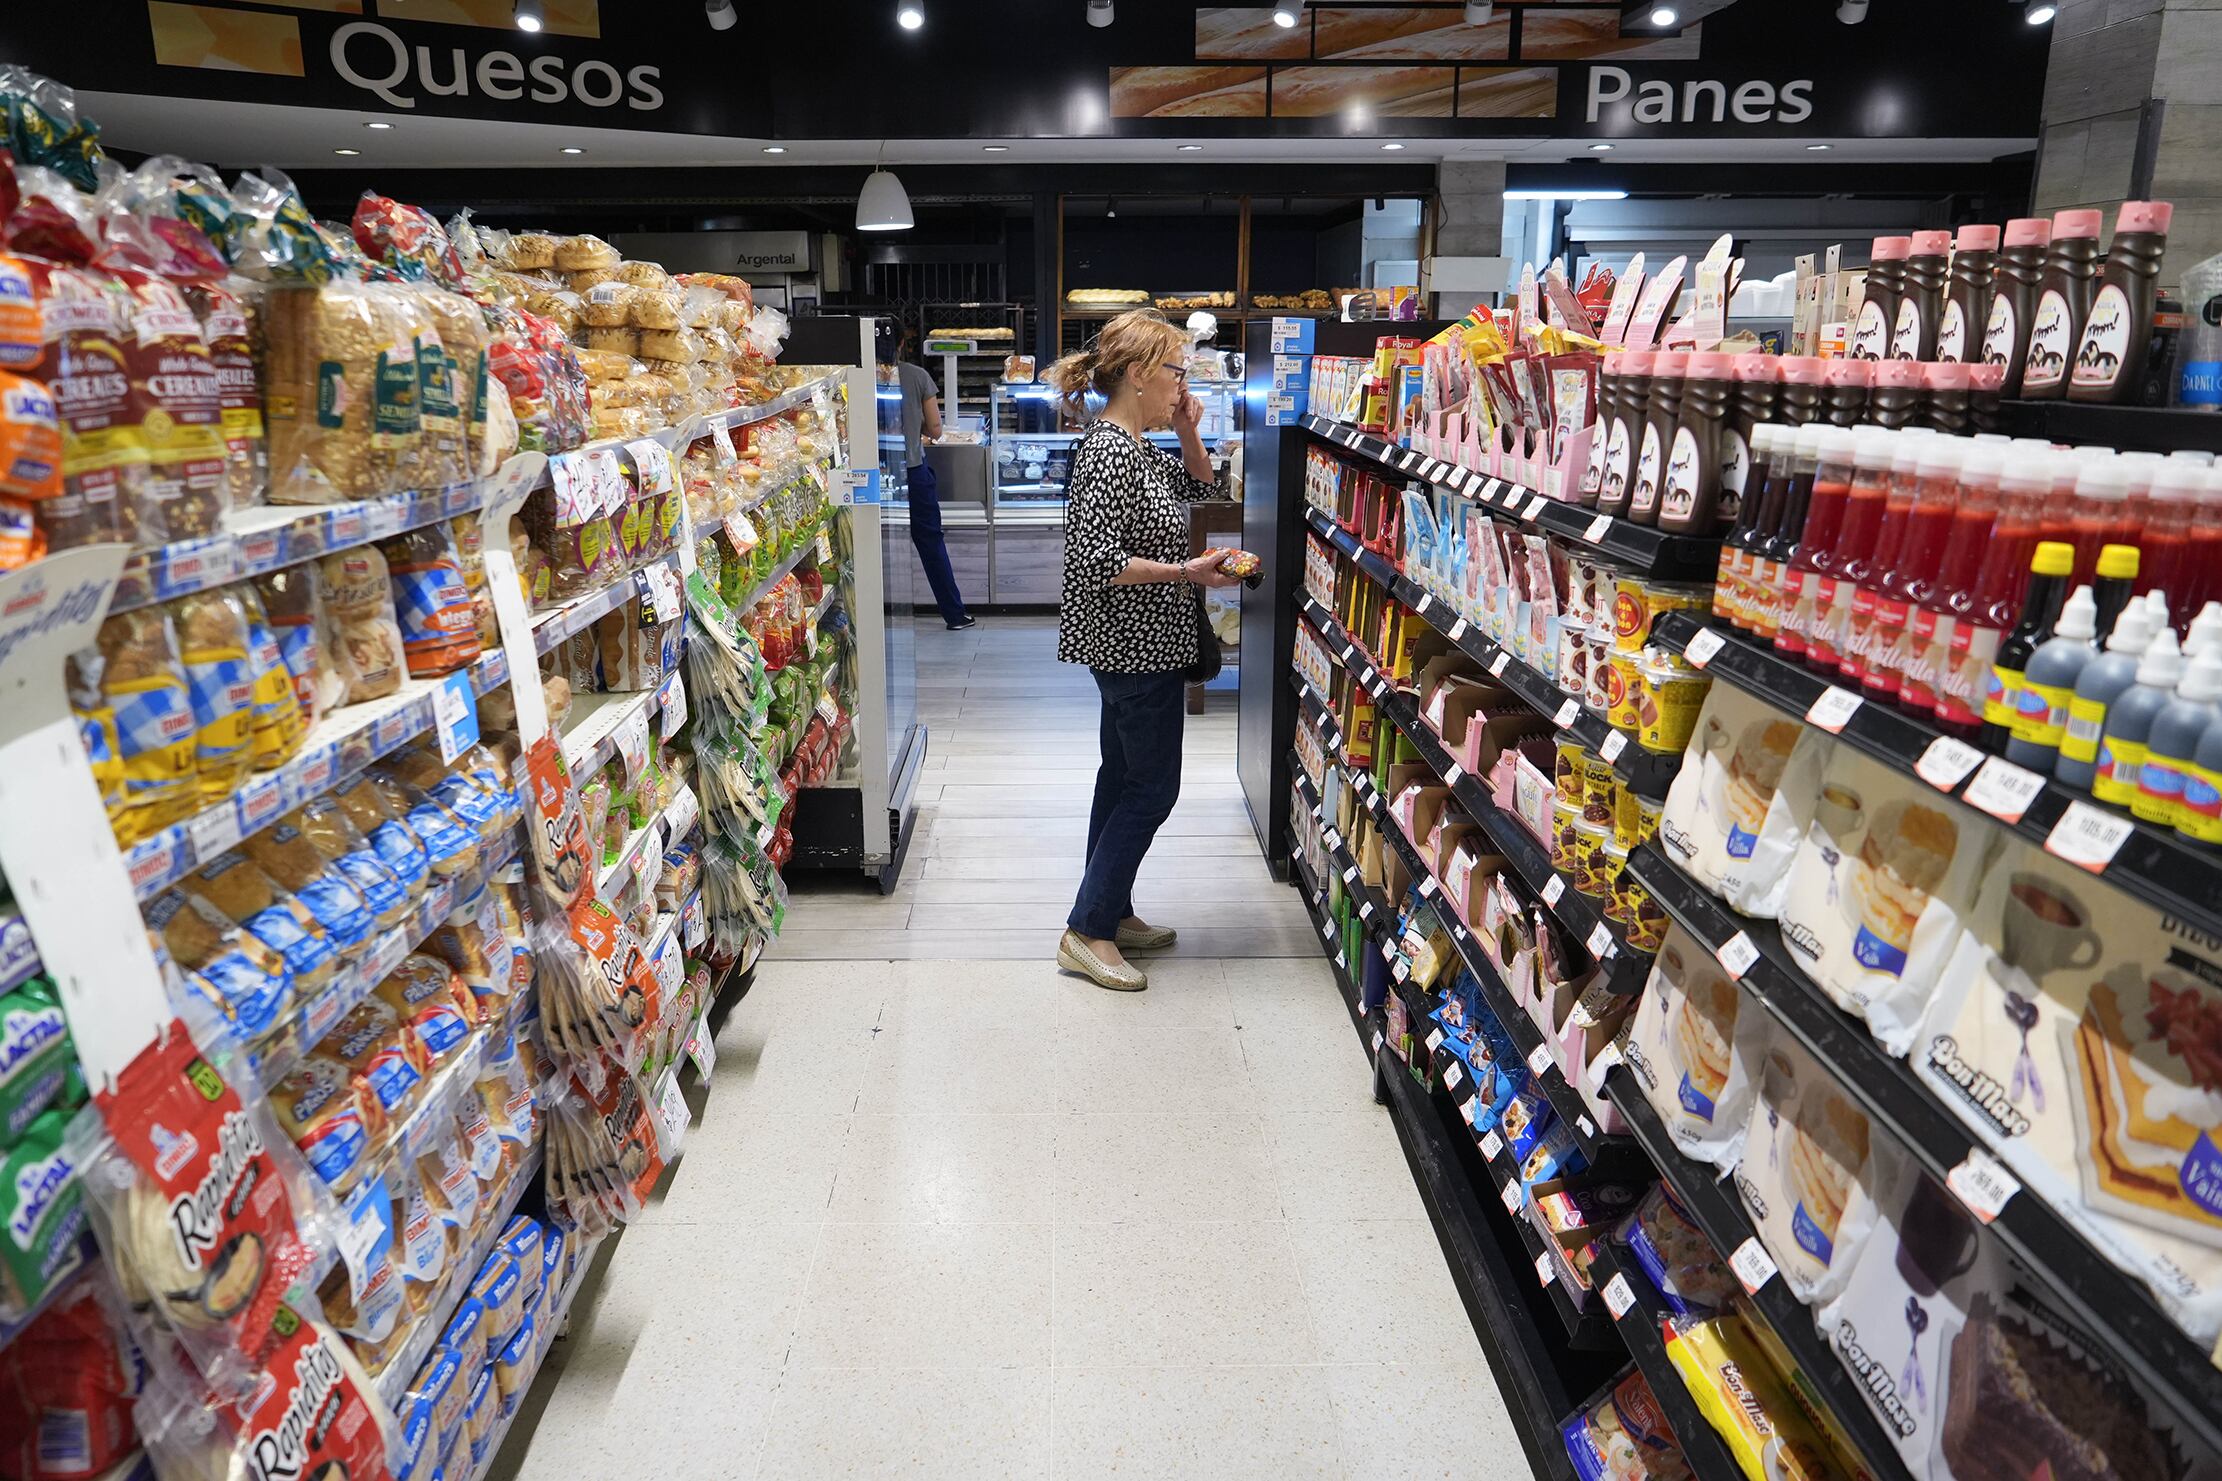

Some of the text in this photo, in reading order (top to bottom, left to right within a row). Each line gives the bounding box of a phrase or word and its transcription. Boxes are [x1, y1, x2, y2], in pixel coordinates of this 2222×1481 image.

[330, 21, 664, 111] Quesos
[1586, 65, 1814, 125] Panes
[737, 253, 795, 268] Argental
[1392, 337, 1414, 349] Royal
